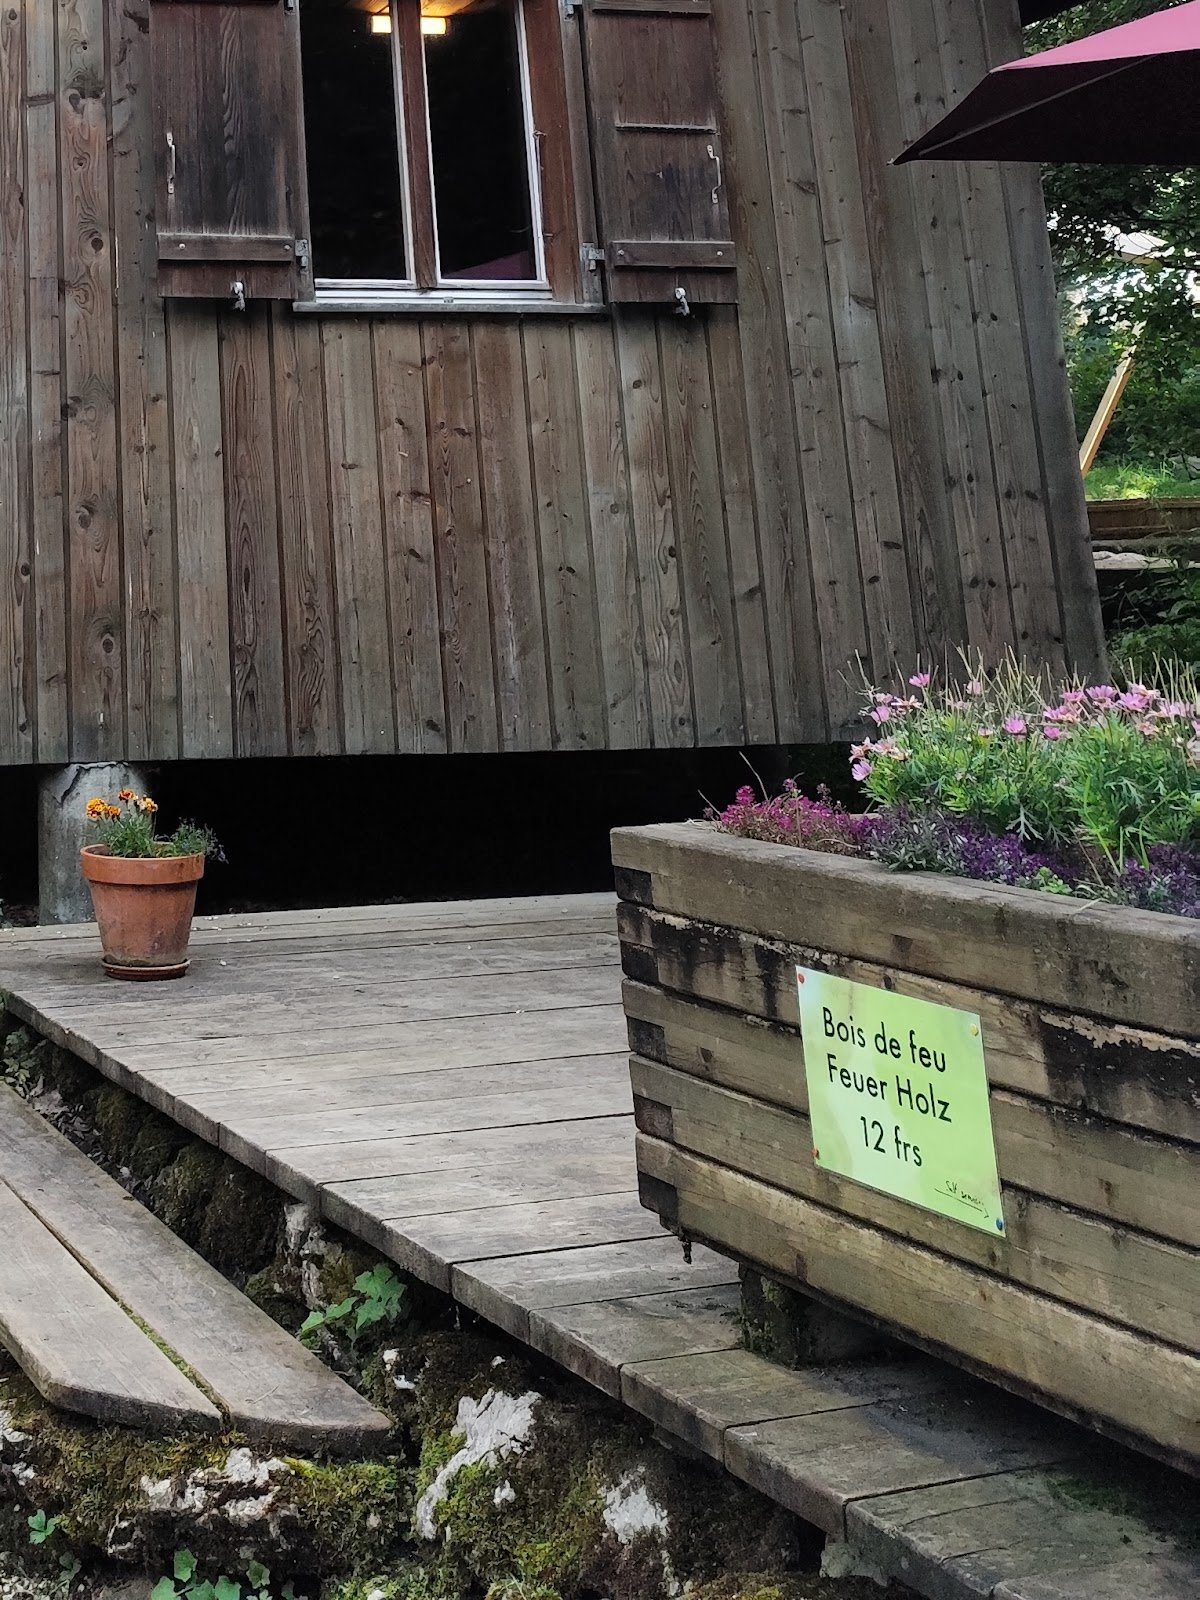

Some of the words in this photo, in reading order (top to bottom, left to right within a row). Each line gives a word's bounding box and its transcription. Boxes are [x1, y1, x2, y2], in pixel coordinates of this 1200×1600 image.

[822, 1006, 866, 1048] Bois
[875, 1021, 901, 1059] de
[909, 1030, 946, 1072] feu
[827, 1053, 887, 1100] Feuer
[896, 1075, 952, 1123] Holz
[860, 1116, 886, 1153] 12
[894, 1125, 923, 1167] frs
